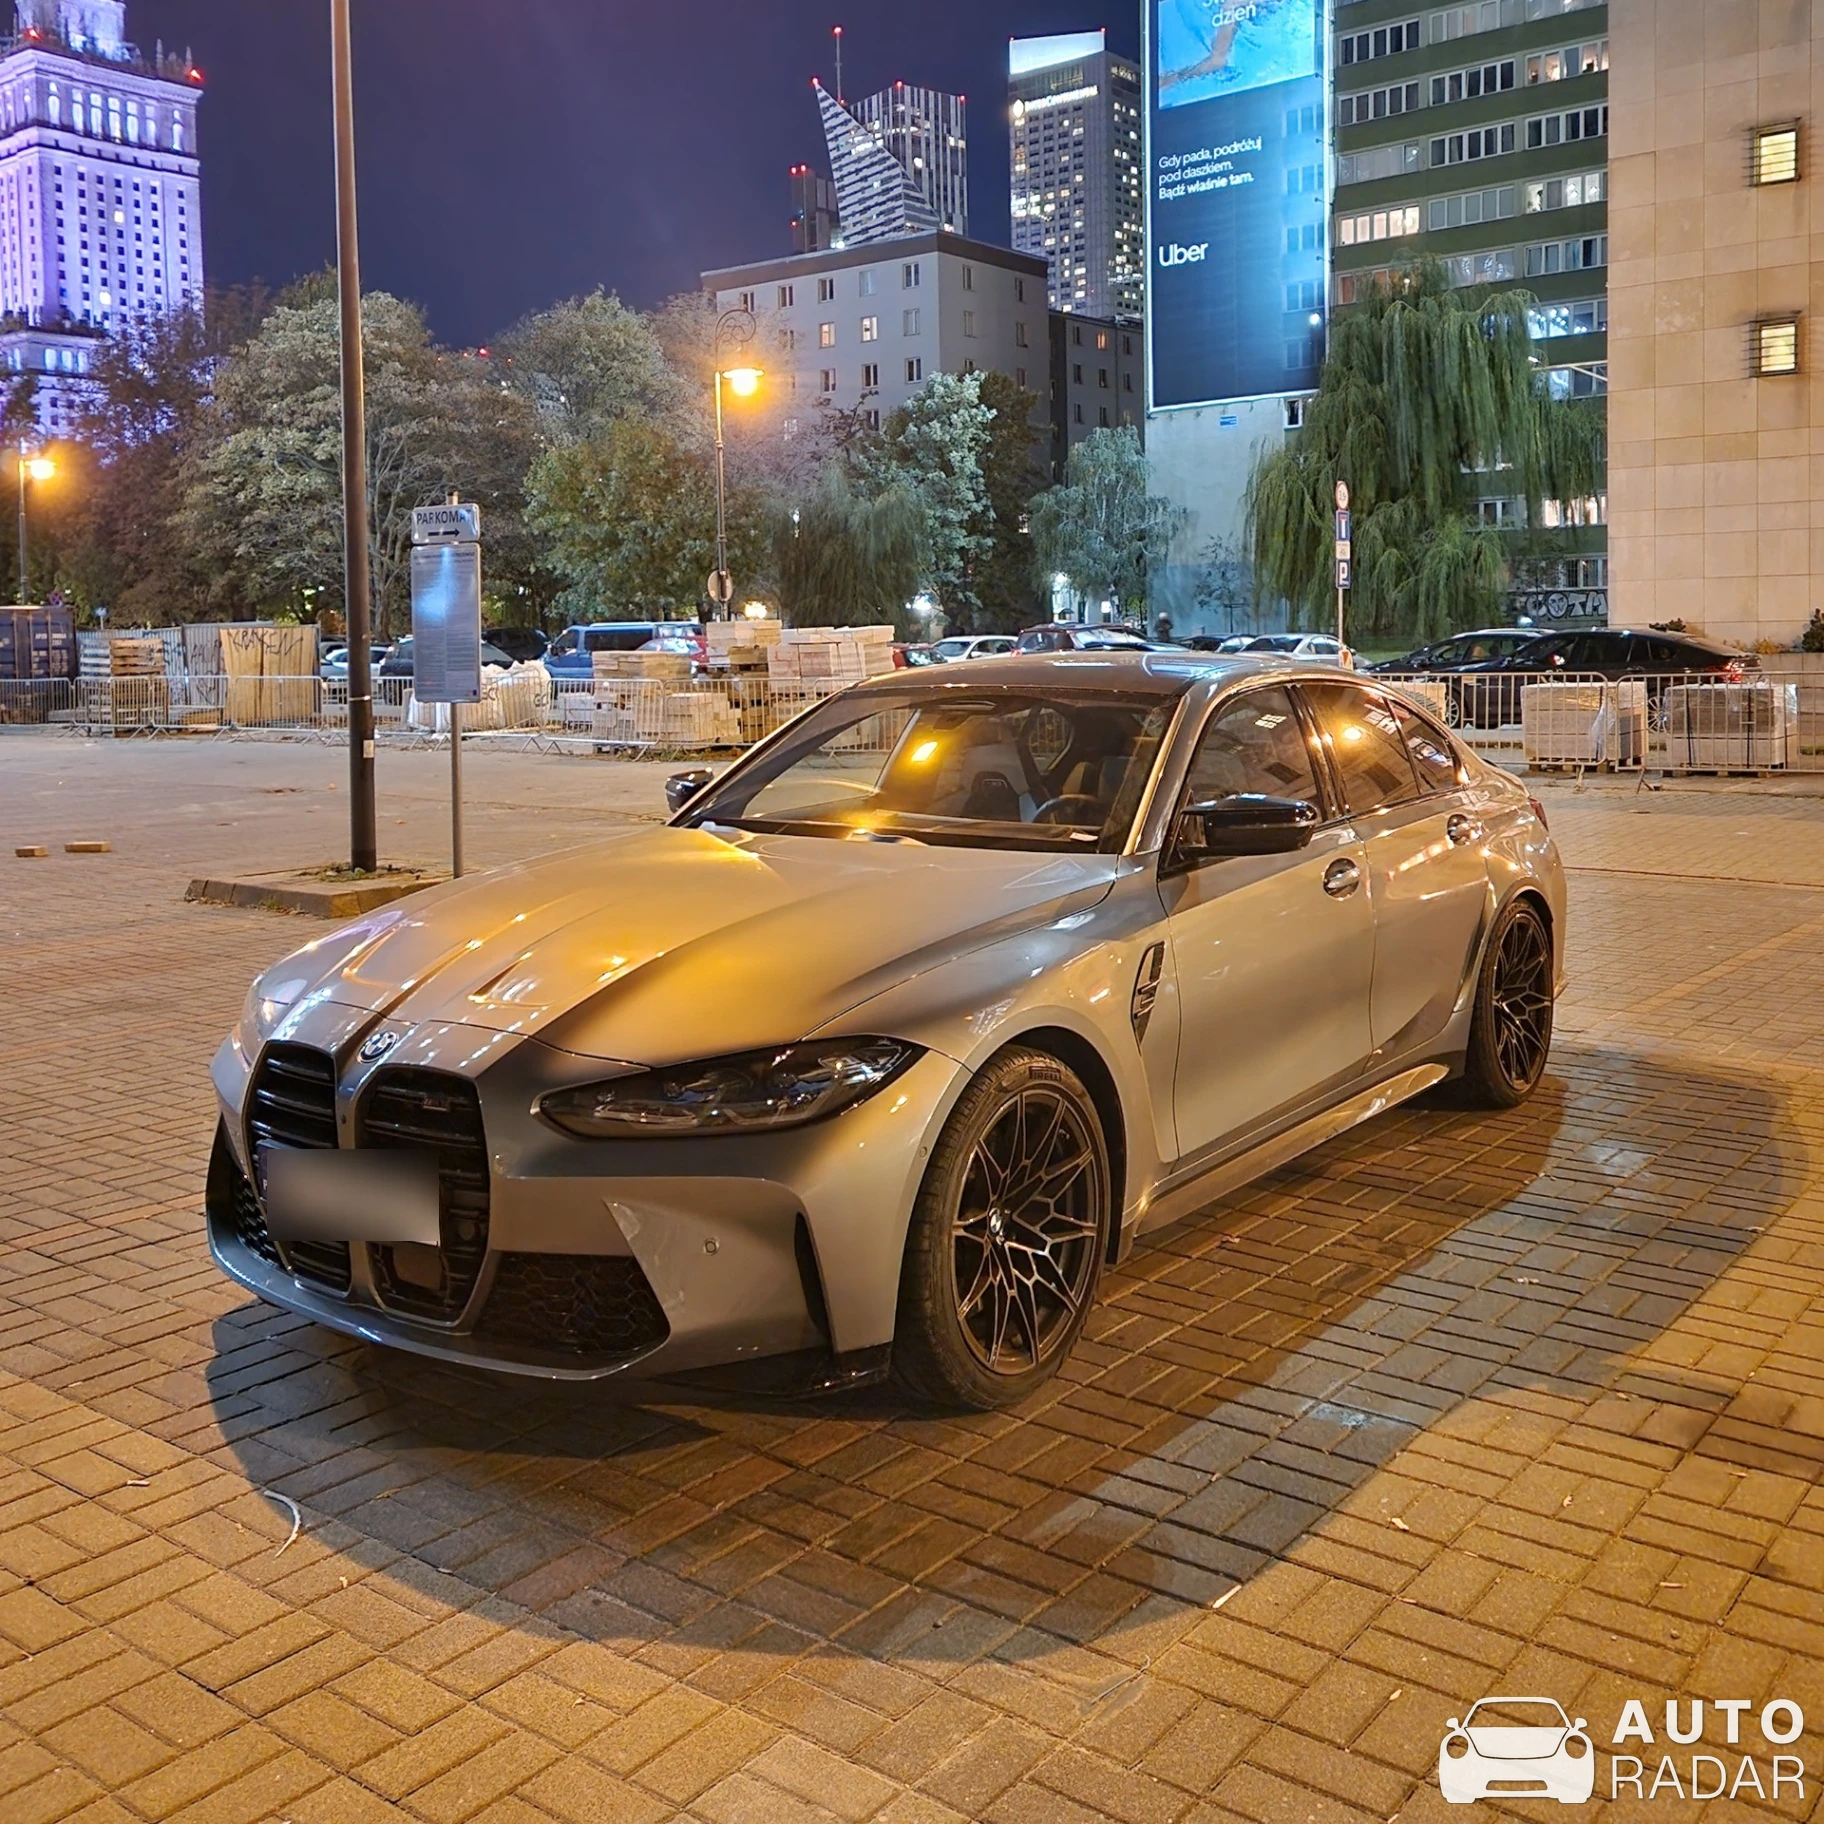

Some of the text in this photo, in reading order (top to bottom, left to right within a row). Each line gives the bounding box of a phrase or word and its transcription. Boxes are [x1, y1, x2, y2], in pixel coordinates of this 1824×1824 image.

[1158, 136, 1262, 169] Gdy pada, podróżuj
[1158, 160, 1233, 186] pod daszkiem.
[1158, 171, 1254, 200] Bądź właśnie tam.
[1158, 242, 1209, 267] Uber
